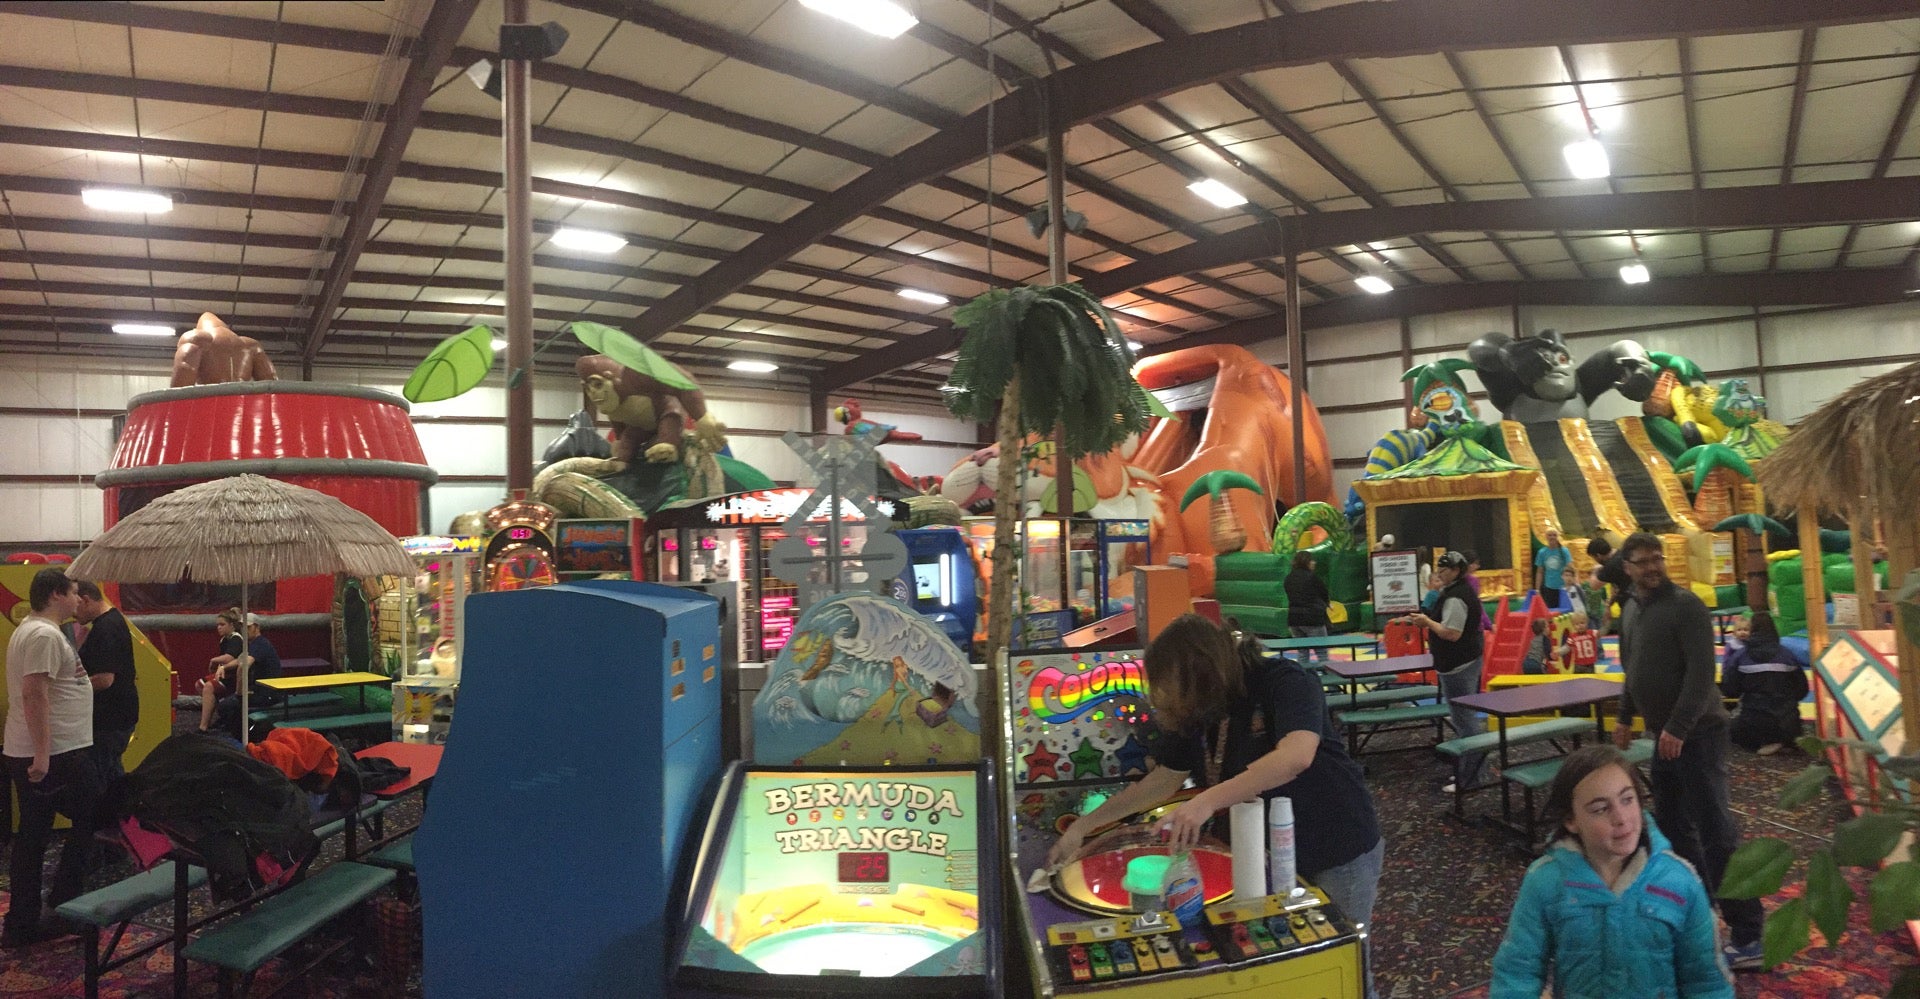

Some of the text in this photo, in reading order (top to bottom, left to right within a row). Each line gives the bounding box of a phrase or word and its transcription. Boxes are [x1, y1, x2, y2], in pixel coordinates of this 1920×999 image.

[1576, 640, 1594, 658] 18
[765, 783, 962, 817] BERMUDA
[776, 827, 947, 856] TRIANGLE
[857, 856, 886, 878] 25
